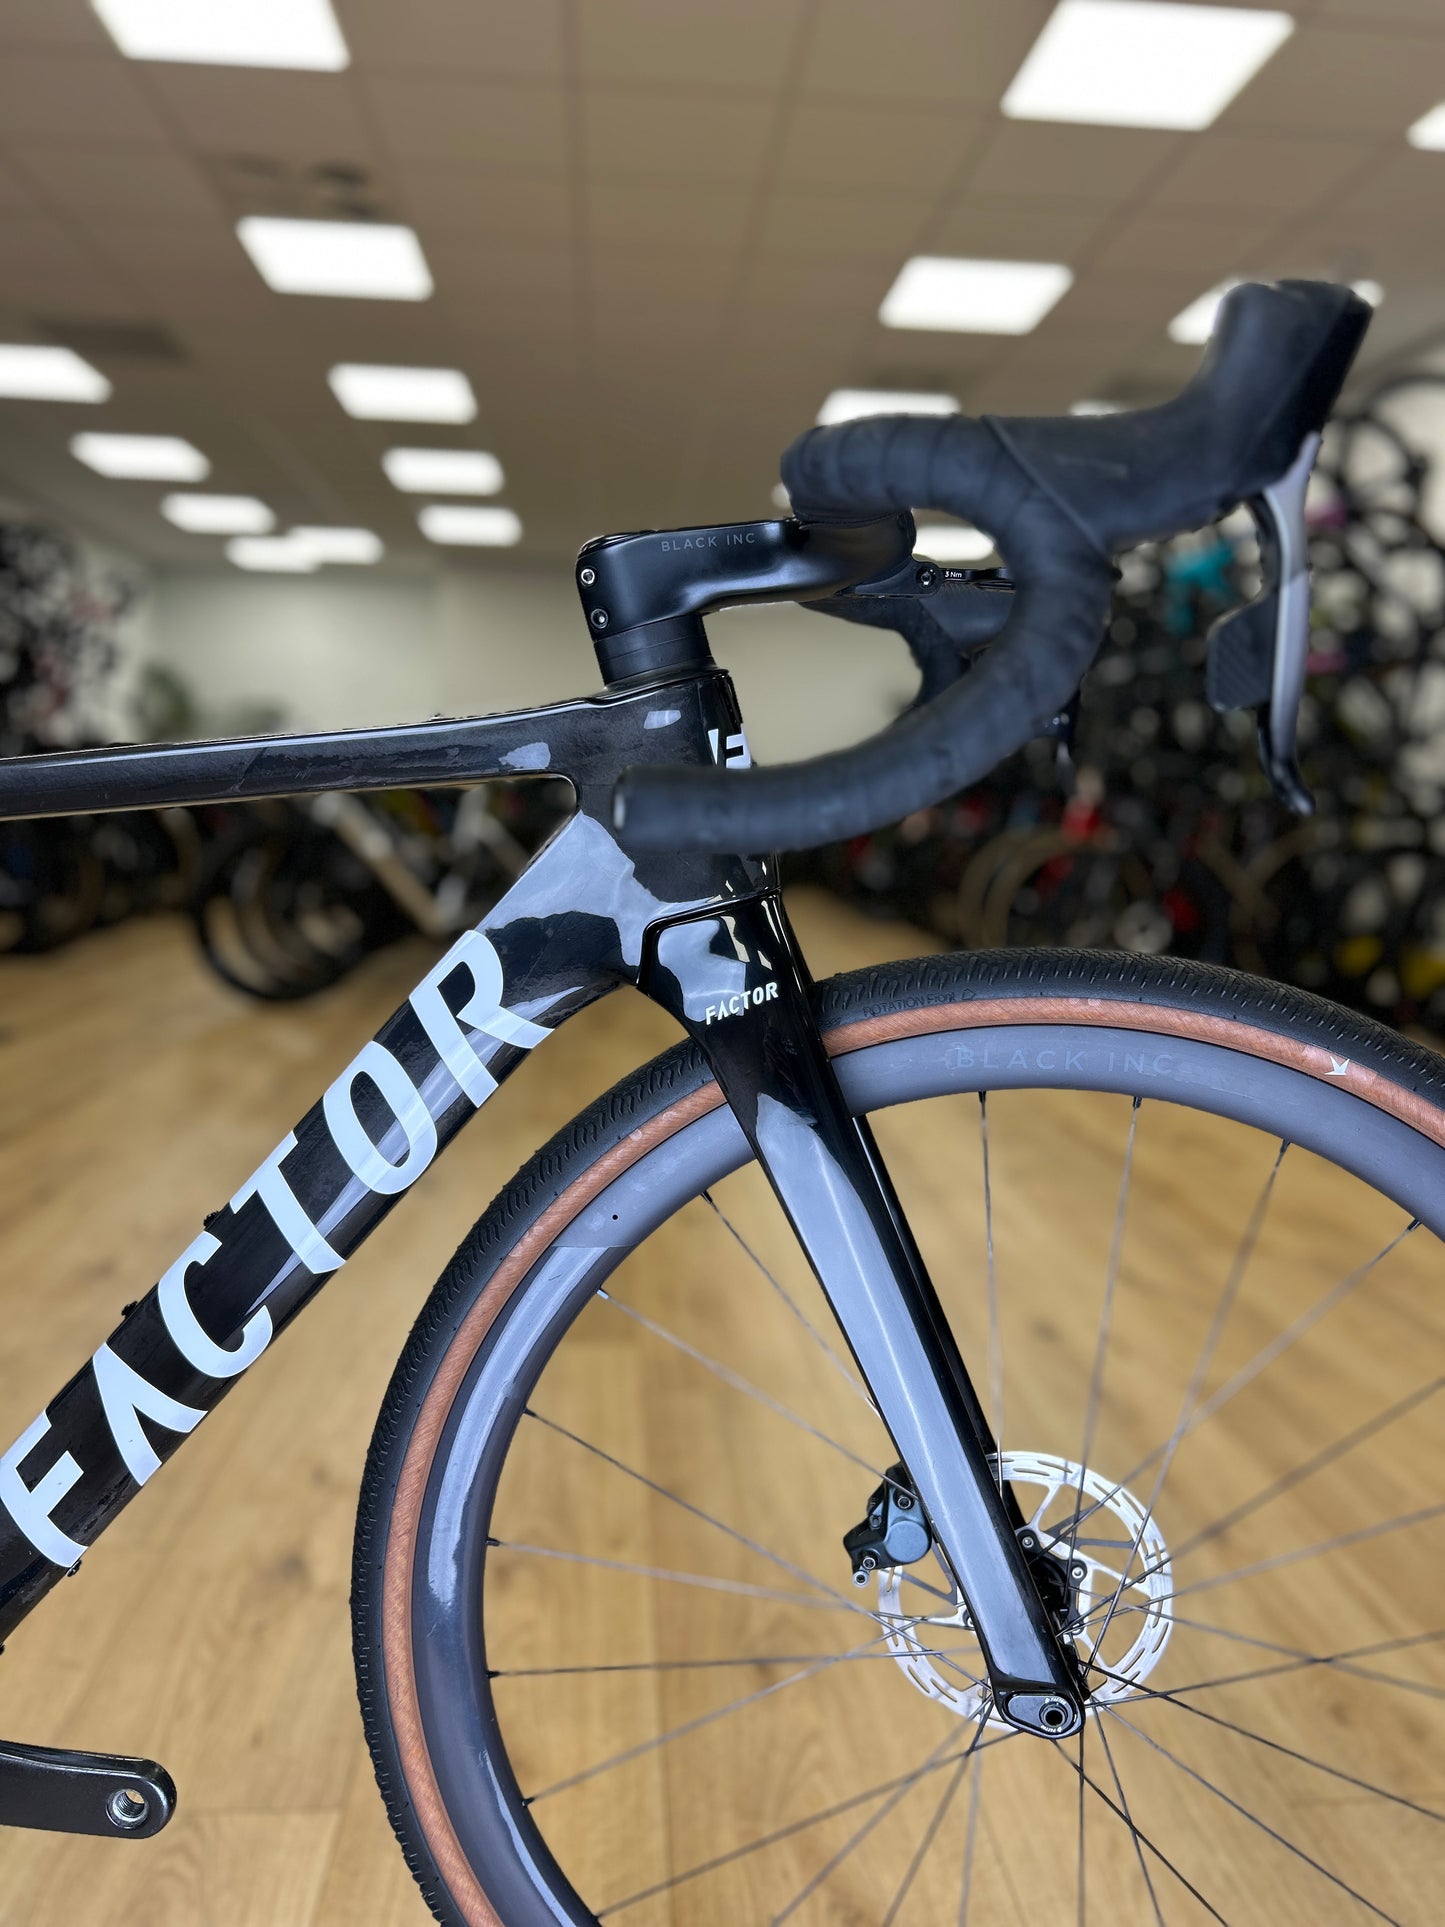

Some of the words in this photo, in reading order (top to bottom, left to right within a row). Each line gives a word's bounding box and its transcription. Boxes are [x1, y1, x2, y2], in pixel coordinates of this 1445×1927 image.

[661, 536, 717, 552] BLACK
[726, 533, 755, 546] INC
[705, 981, 779, 1026] FACTOR
[863, 996, 925, 1018] ROTATION
[957, 1049, 1084, 1071] BLACK
[1108, 1052, 1173, 1074] INC
[0, 930, 556, 1568] FACTOR
